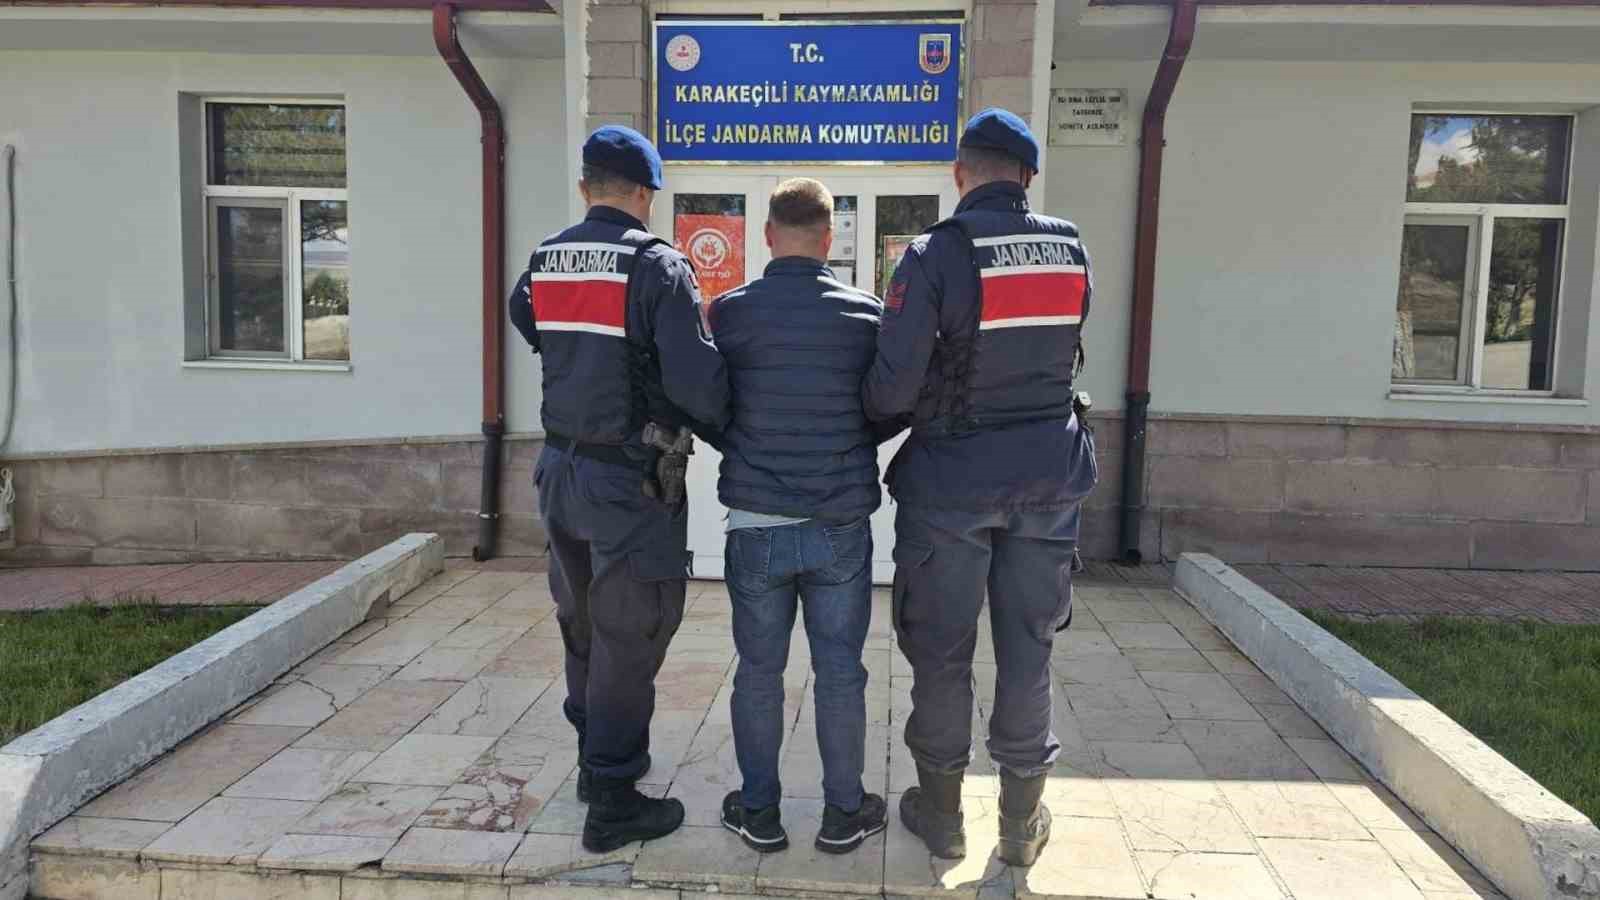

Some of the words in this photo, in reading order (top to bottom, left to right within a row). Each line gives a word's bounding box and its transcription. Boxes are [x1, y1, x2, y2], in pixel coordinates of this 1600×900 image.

[789, 43, 824, 63] T.C.
[675, 80, 788, 108] KARAKEÇİLİ
[794, 79, 939, 103] KAYMAKAMLIĞI
[665, 119, 707, 148] İLÇE
[710, 123, 813, 144] JANDARMA
[818, 119, 948, 144] KOMUTANLIĞI
[540, 249, 618, 273] JANDARMA
[992, 243, 1074, 267] JANDARMA
